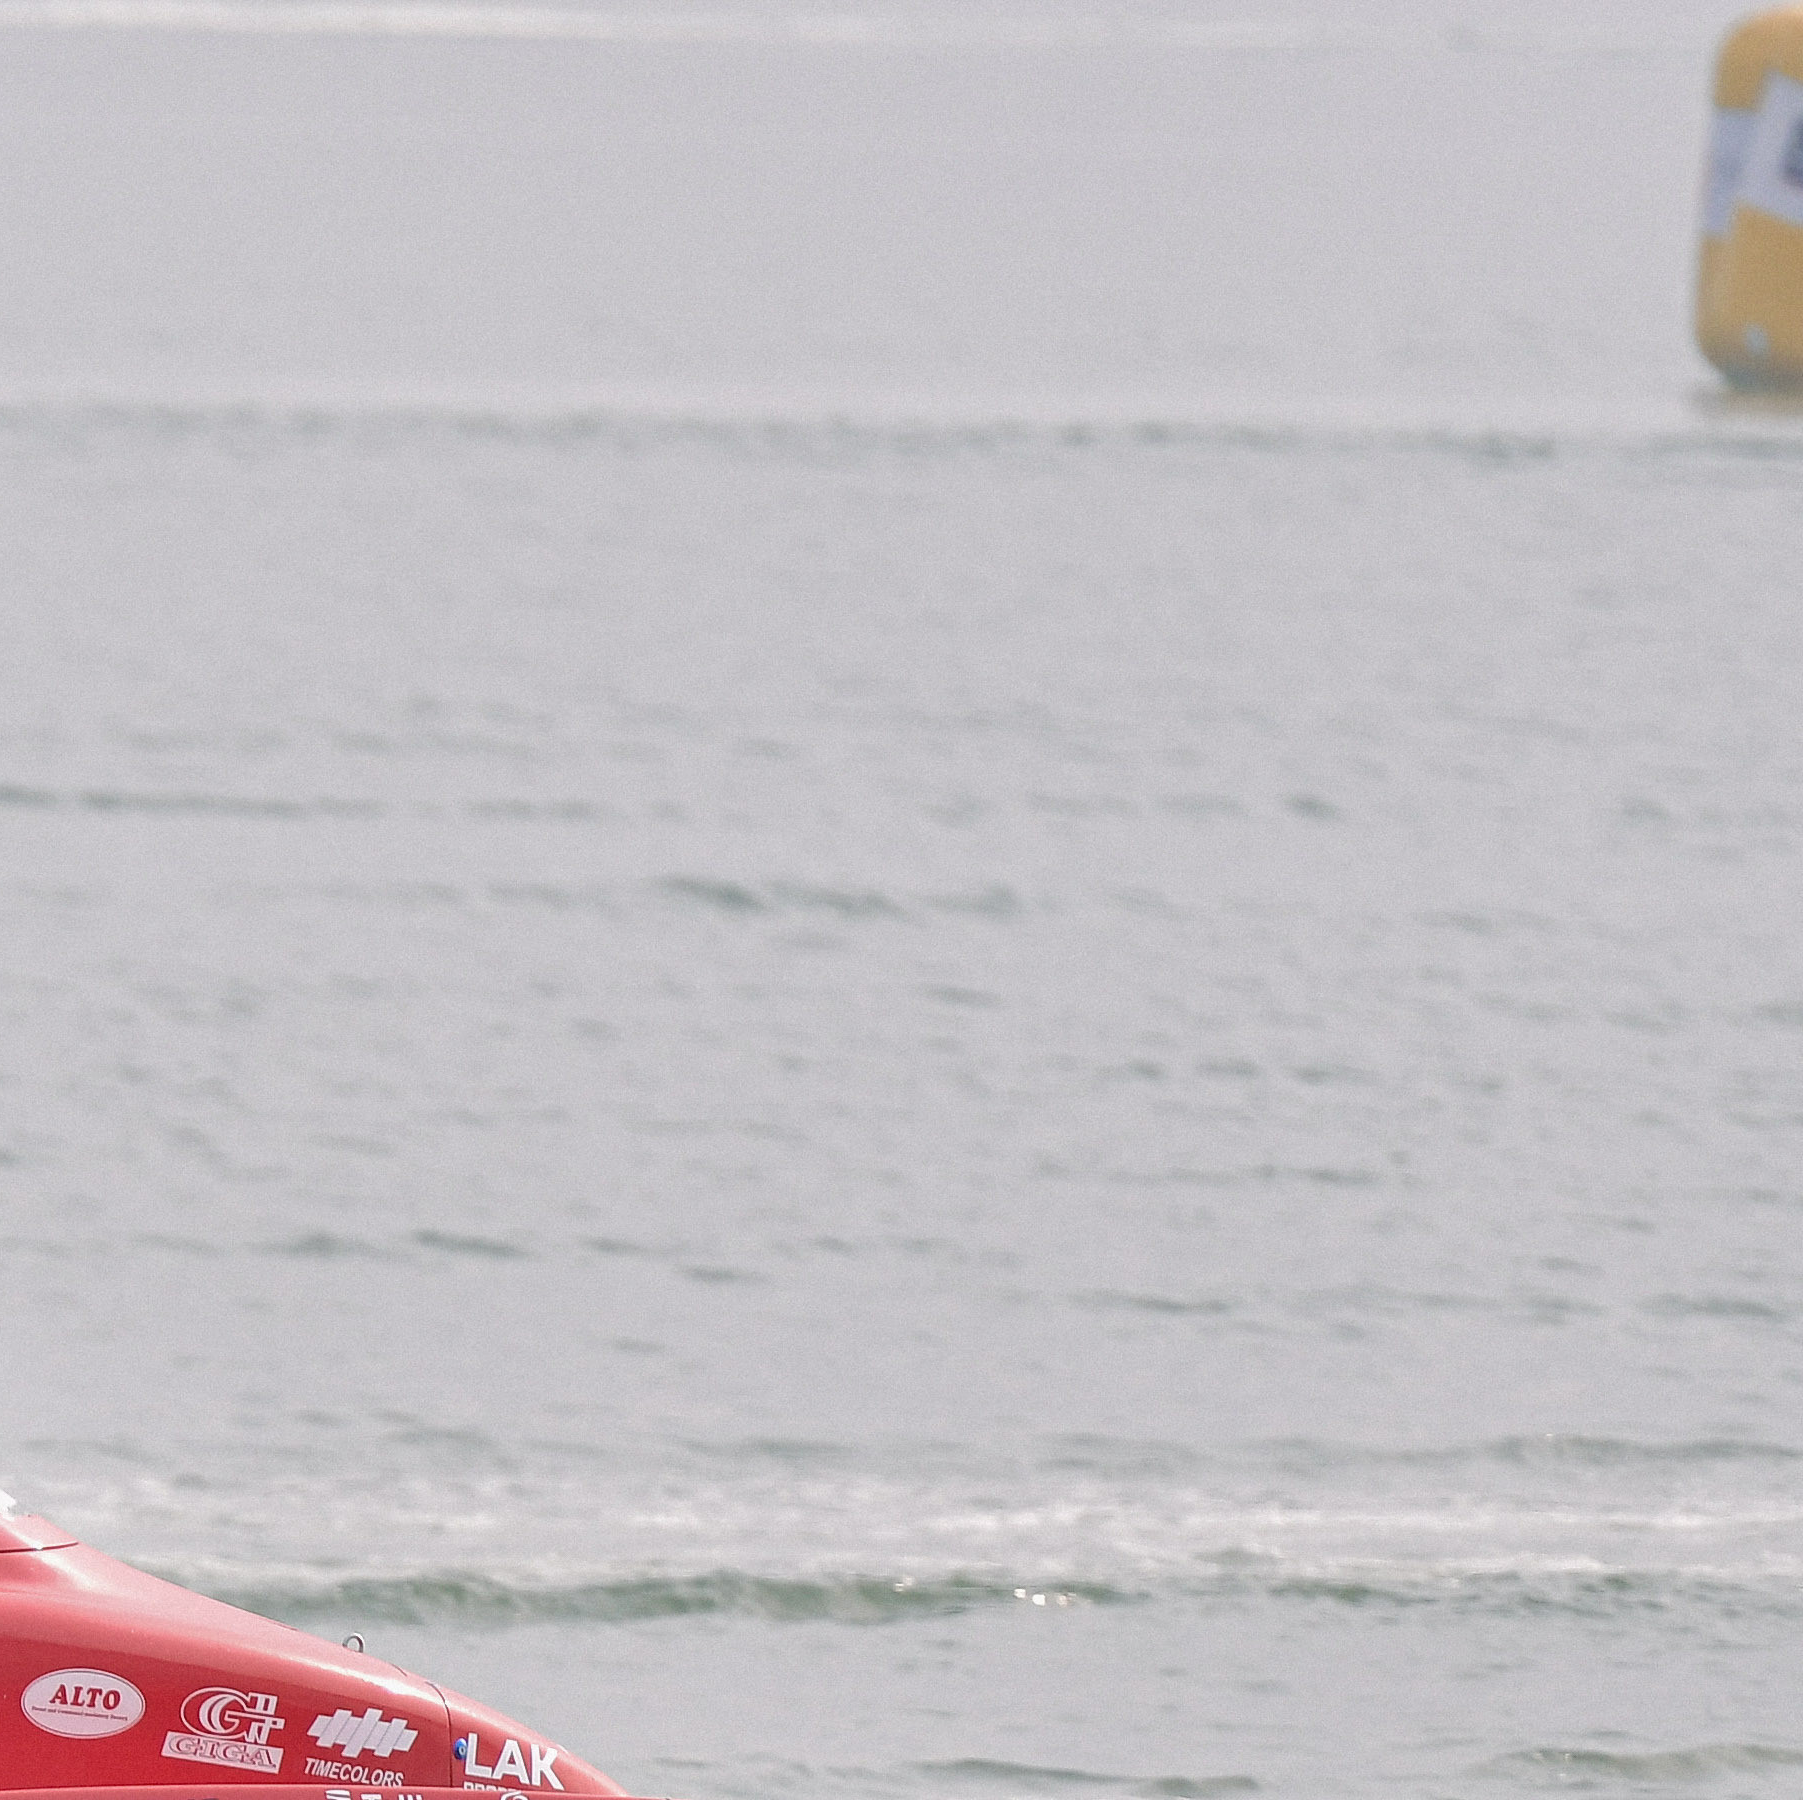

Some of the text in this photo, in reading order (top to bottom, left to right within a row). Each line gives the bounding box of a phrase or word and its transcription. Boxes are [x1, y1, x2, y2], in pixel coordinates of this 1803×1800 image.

[49, 1684, 121, 1710] ALTO
[167, 1735, 278, 1769] GIGA
[464, 1732, 565, 1791] LAK
[304, 1757, 404, 1787] TIMECOLORS
